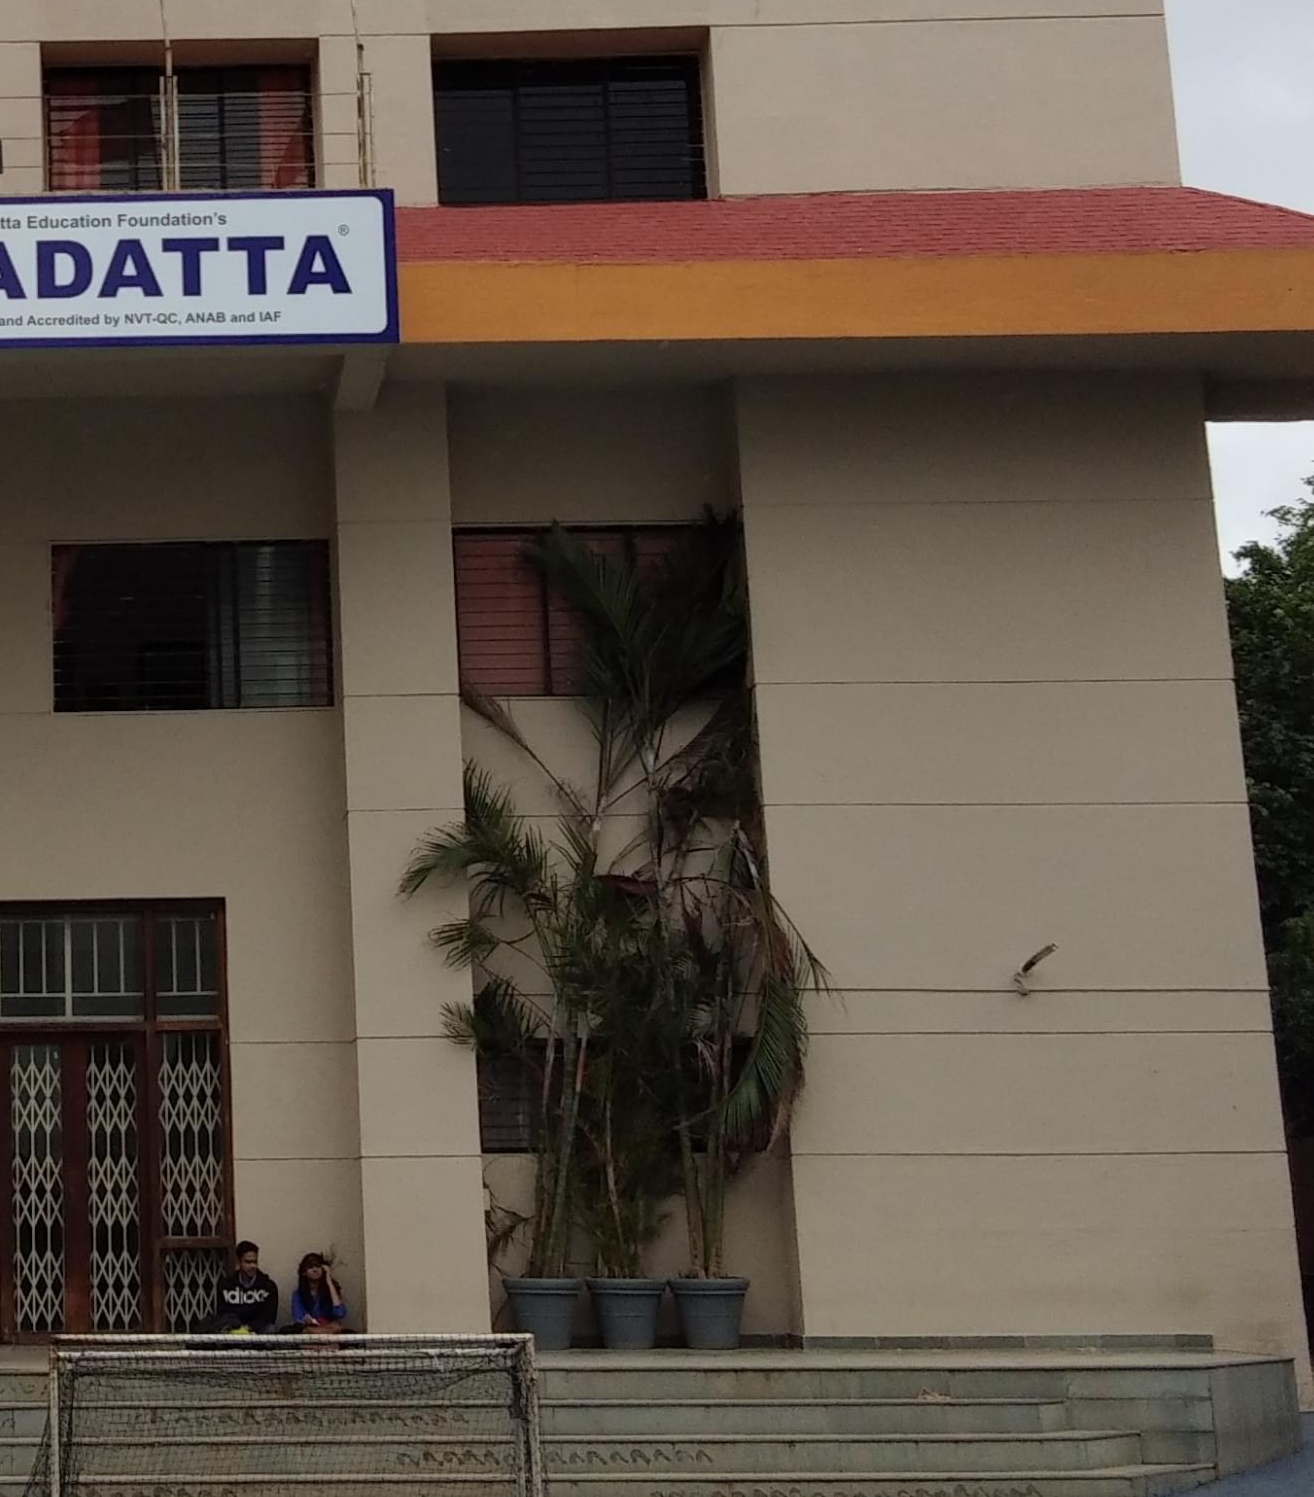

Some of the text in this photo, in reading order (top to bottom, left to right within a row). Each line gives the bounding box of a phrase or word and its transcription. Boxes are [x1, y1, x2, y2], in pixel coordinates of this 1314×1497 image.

[27, 214, 111, 229] Education
[118, 212, 227, 227] Foundation's
[27, 314, 100, 326] Accredited
[104, 313, 119, 328] by
[124, 313, 182, 325] NVT-QC,
[186, 311, 226, 323] ANAB
[230, 311, 255, 323] and
[260, 310, 282, 322] IAF
